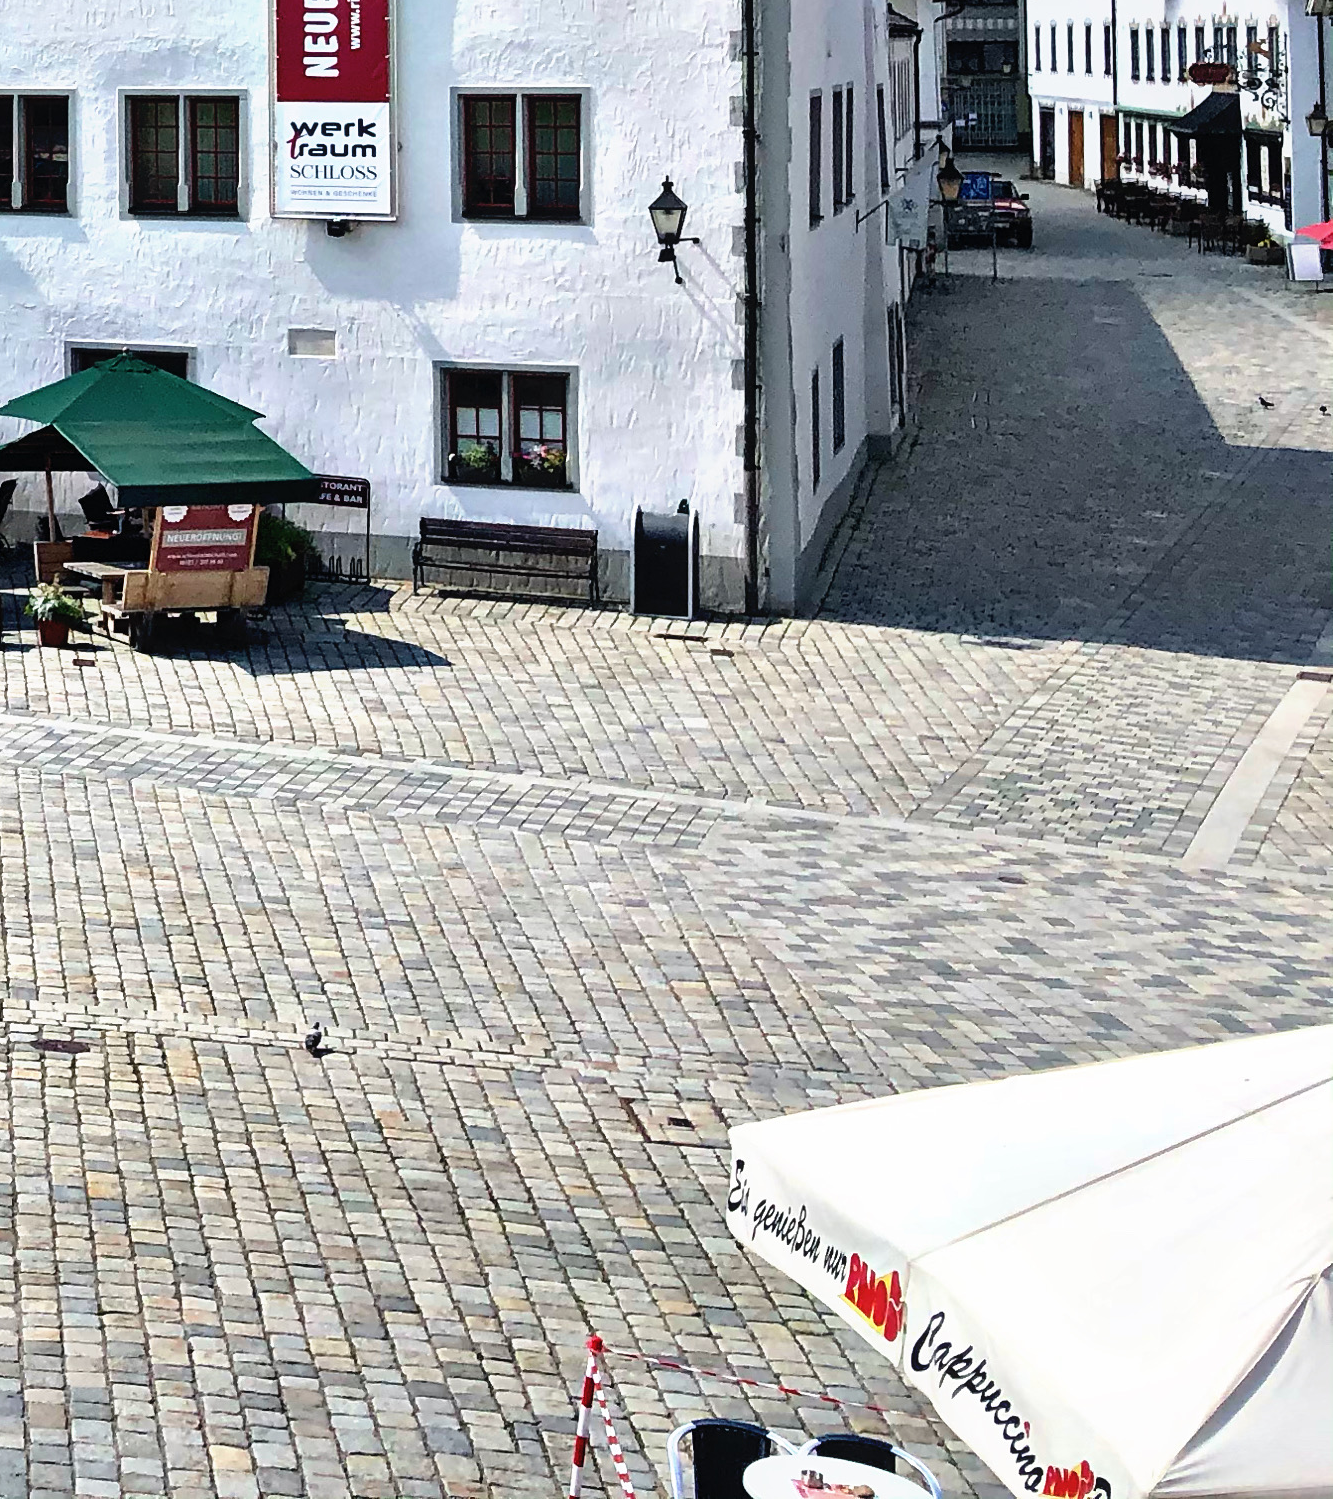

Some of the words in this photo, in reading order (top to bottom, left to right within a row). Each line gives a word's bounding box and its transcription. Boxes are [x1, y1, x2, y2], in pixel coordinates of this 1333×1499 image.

[290, 118, 377, 138] werk
[290, 164, 378, 180] SCHLOSS
[333, 190, 378, 198] GESCHENKE
[334, 493, 341, 502] &
[344, 494, 363, 504] BAR
[752, 1199, 821, 1264] genießen
[824, 1244, 848, 1284] nur
[910, 1311, 1044, 1493] Cappuccino
